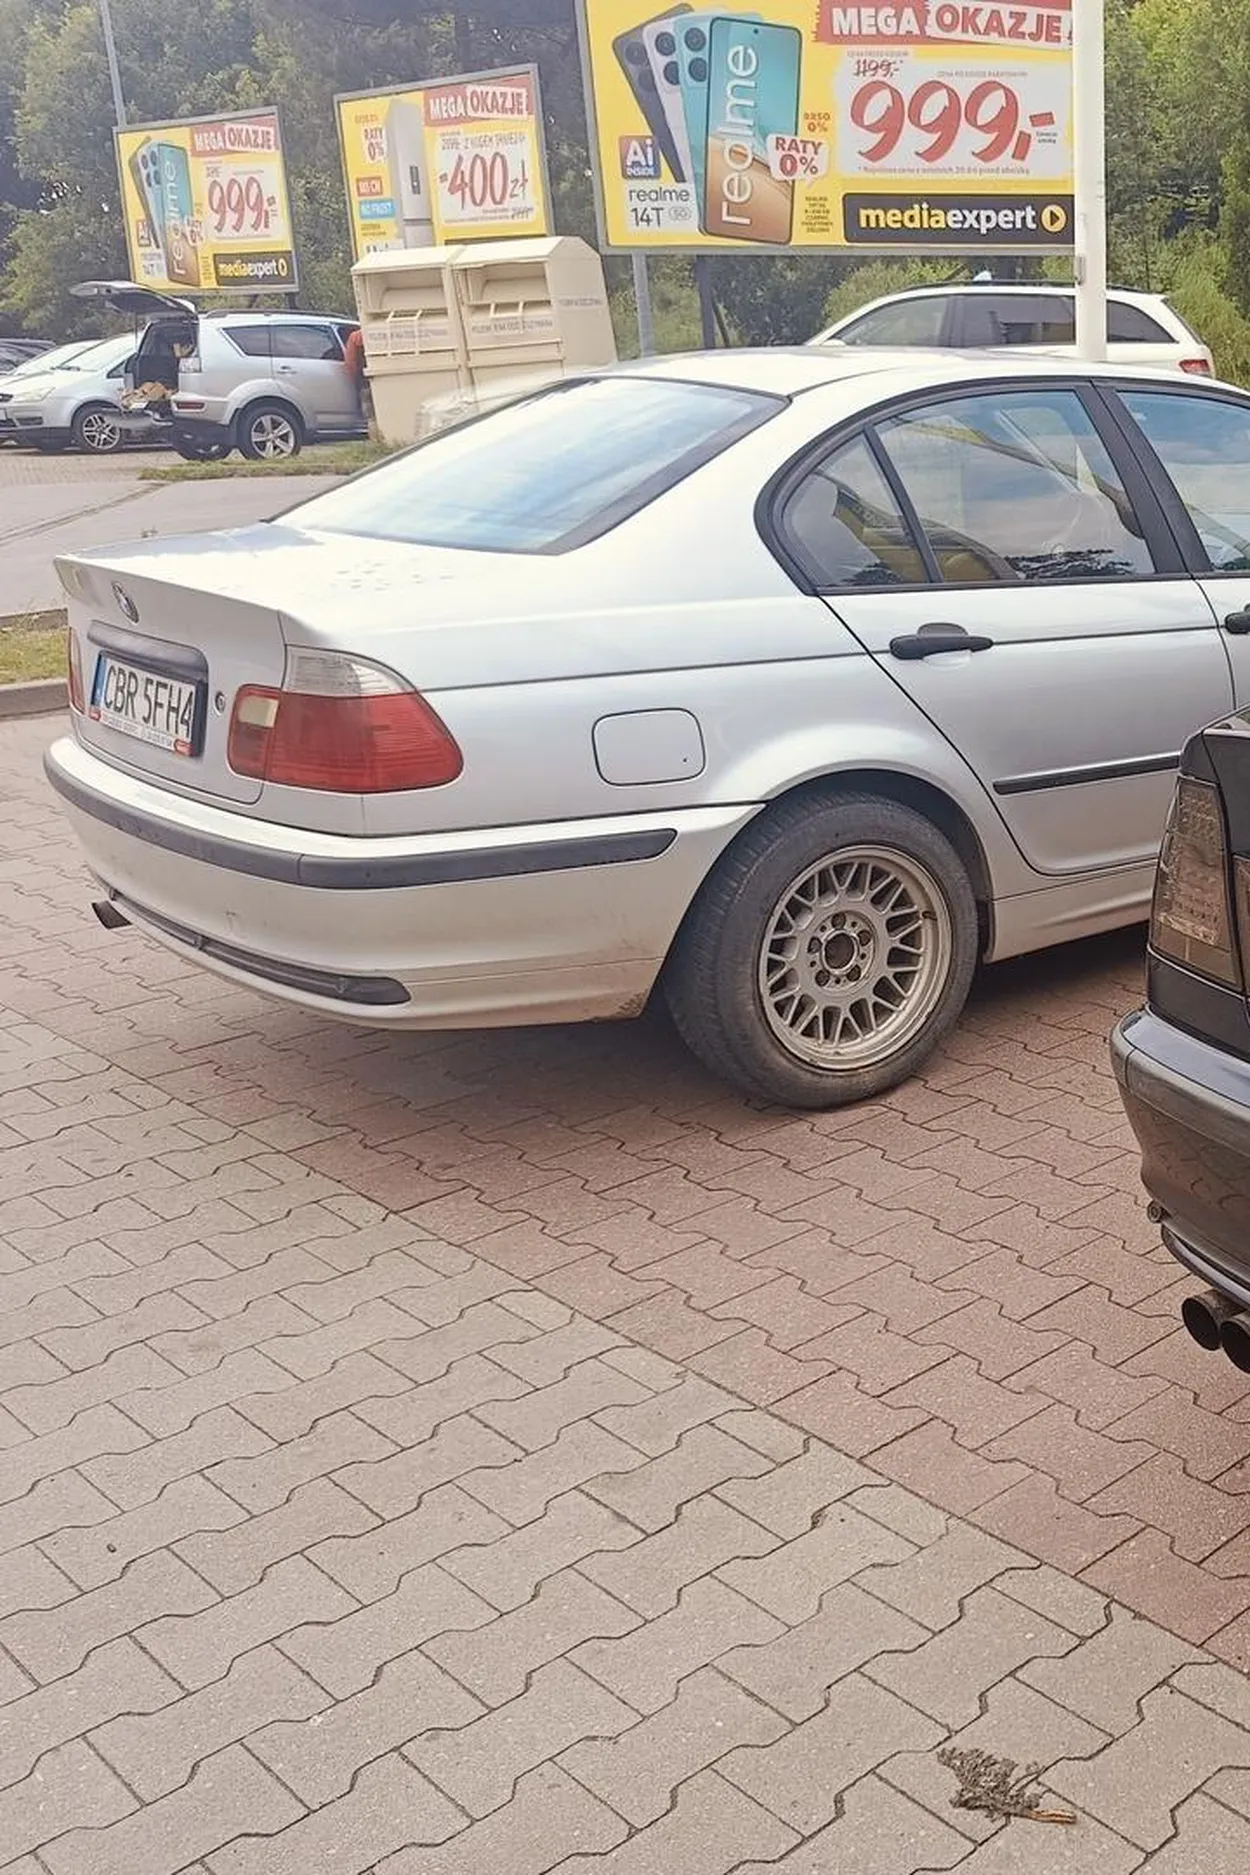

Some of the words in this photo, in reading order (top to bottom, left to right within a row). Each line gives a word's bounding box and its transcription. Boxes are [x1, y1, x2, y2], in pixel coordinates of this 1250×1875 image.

[832, 7, 920, 36] MEGA
[935, 4, 1062, 43] OKAZJE
[430, 95, 466, 119] MEGA
[470, 90, 525, 115] OKAZJE
[717, 44, 758, 225] realme
[807, 122, 828, 132] 0%
[775, 137, 823, 155] RATY
[779, 155, 818, 176] 0%
[629, 187, 690, 202] realme
[165, 161, 187, 276] realme
[631, 207, 665, 228] 14T
[859, 202, 1037, 234] mediaexpert
[218, 258, 278, 279] mediaexpert
[104, 665, 138, 719] CBR
[142, 677, 193, 738] 5FH4
